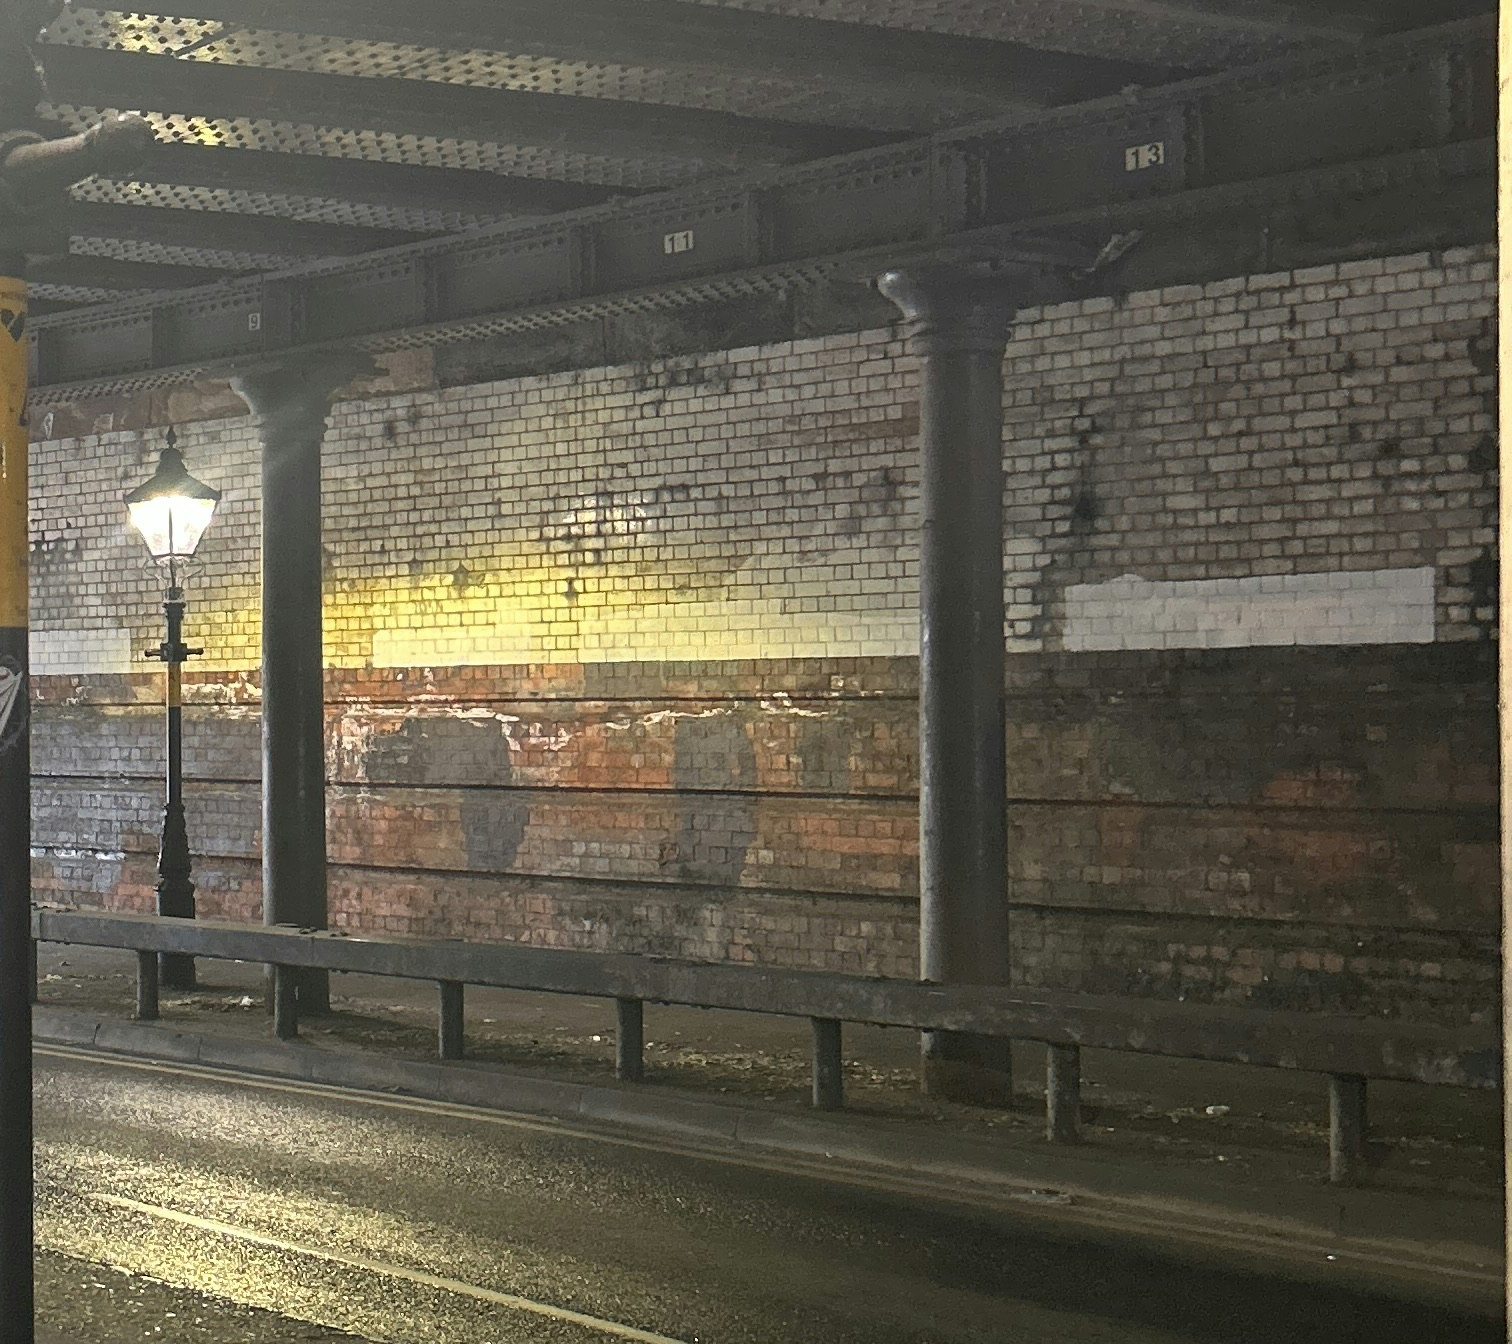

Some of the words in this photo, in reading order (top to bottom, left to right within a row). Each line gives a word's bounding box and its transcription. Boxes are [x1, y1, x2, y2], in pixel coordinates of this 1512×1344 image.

[1130, 143, 1161, 169] 13
[668, 231, 690, 253] 11
[250, 314, 258, 329] 9
